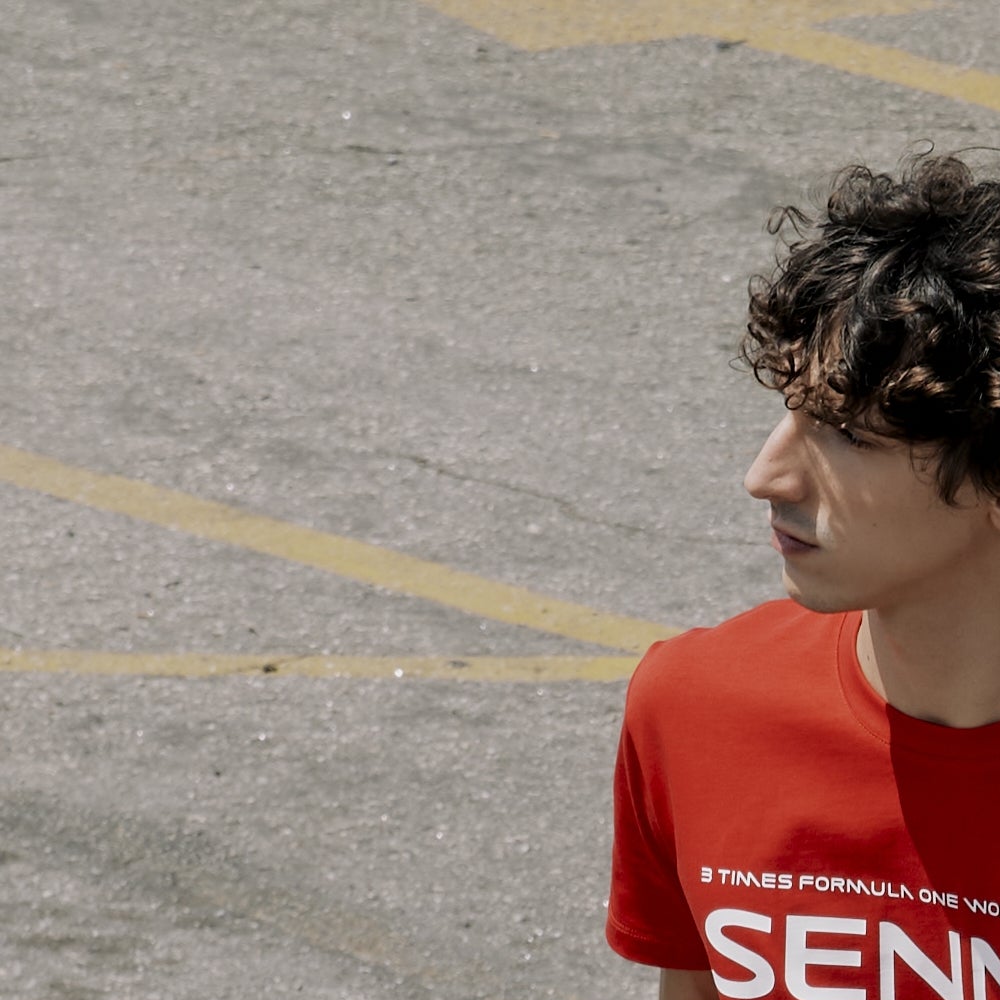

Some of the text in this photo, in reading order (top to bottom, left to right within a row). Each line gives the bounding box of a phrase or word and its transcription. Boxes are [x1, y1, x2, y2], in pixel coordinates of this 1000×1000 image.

[701, 867, 713, 883] 3
[718, 869, 793, 890] TIMES
[799, 875, 914, 900] FORMULA
[918, 888, 959, 909] ONE
